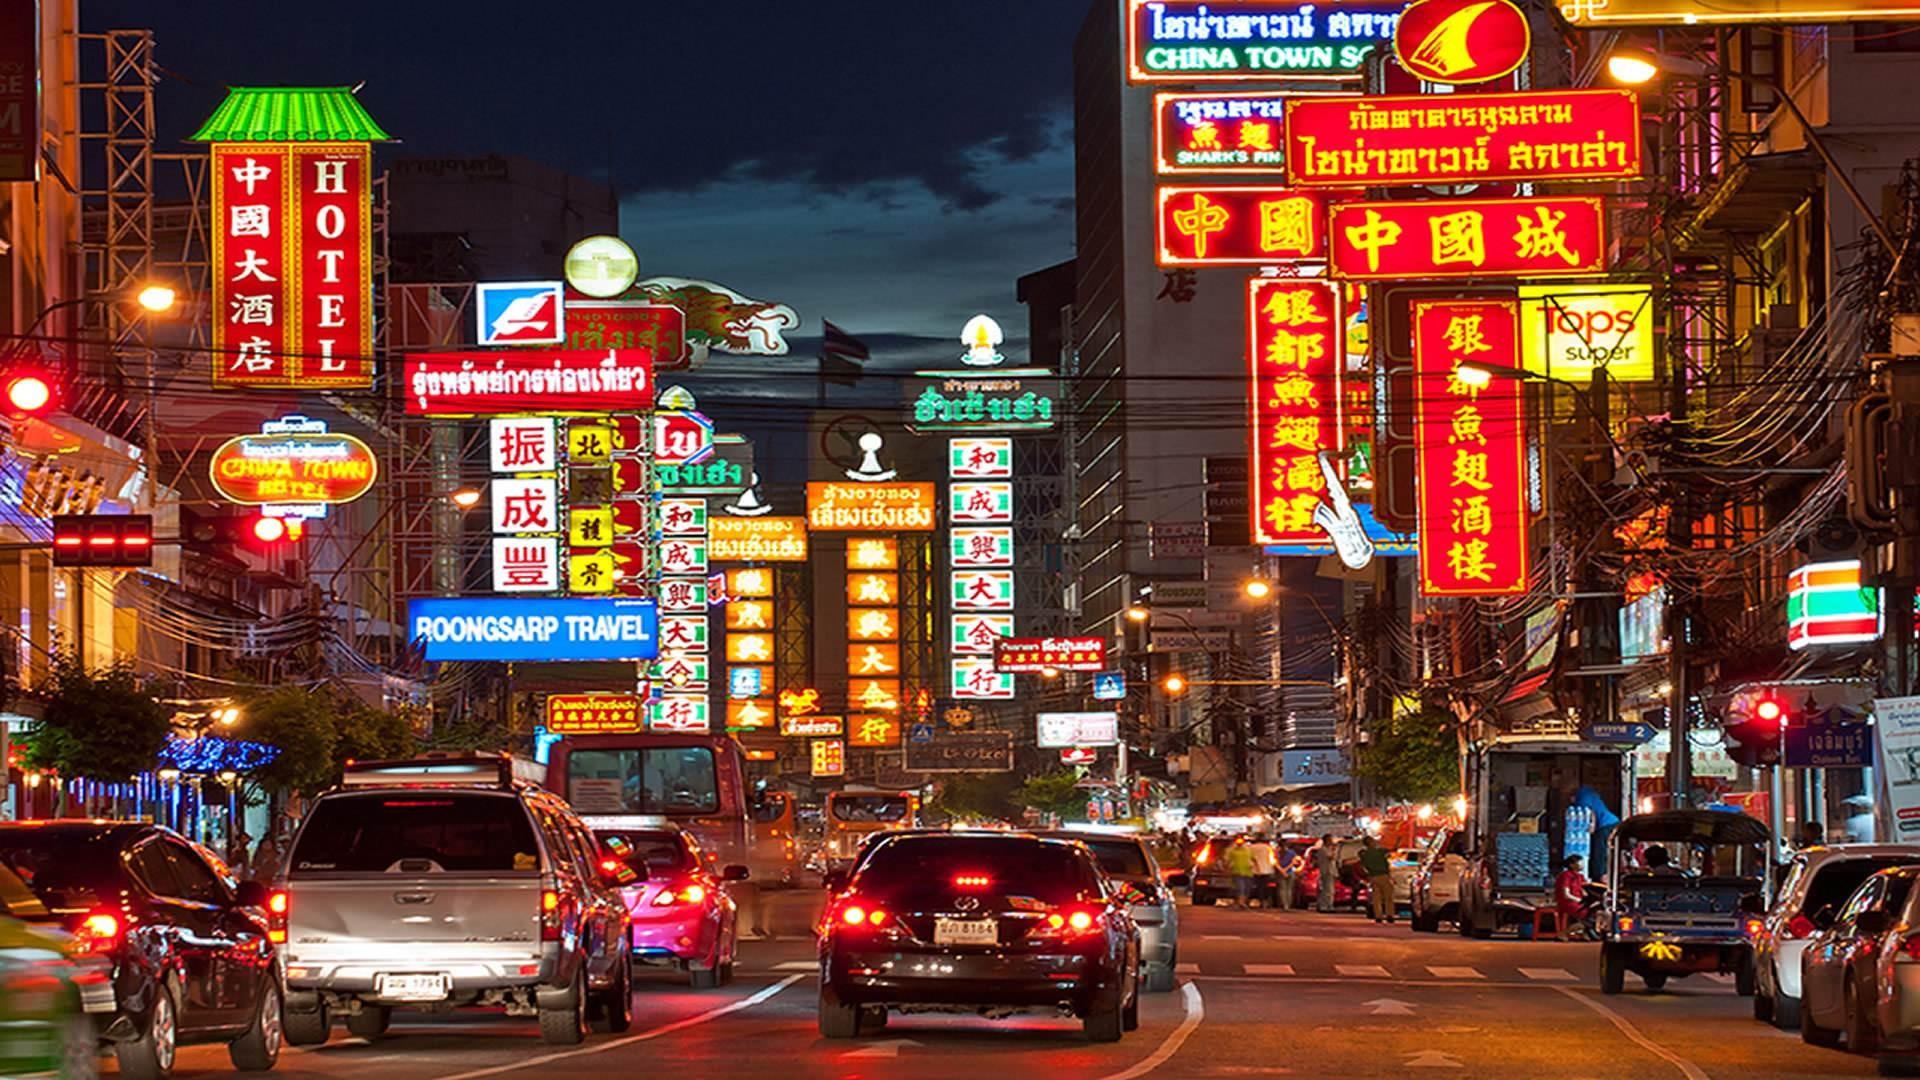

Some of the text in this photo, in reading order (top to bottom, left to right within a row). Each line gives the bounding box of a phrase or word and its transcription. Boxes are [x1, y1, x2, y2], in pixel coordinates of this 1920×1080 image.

[1145, 47, 1238, 69] CHINA
[1244, 46, 1333, 69] TOWN
[1176, 151, 1249, 164] SHARK'S
[1344, 205, 1580, 273] 中國城
[229, 157, 278, 374] 中國大酒店
[313, 161, 347, 373] HOTEL
[1536, 305, 1636, 344] Tops
[1565, 345, 1635, 365] super
[220, 457, 369, 479] CHINA TOWN
[500, 427, 549, 587] 振成豐
[964, 446, 997, 693] 和成興大金行
[416, 614, 650, 643] ROONGSARP TRAVEL
[1634, 726, 1645, 737] 2
